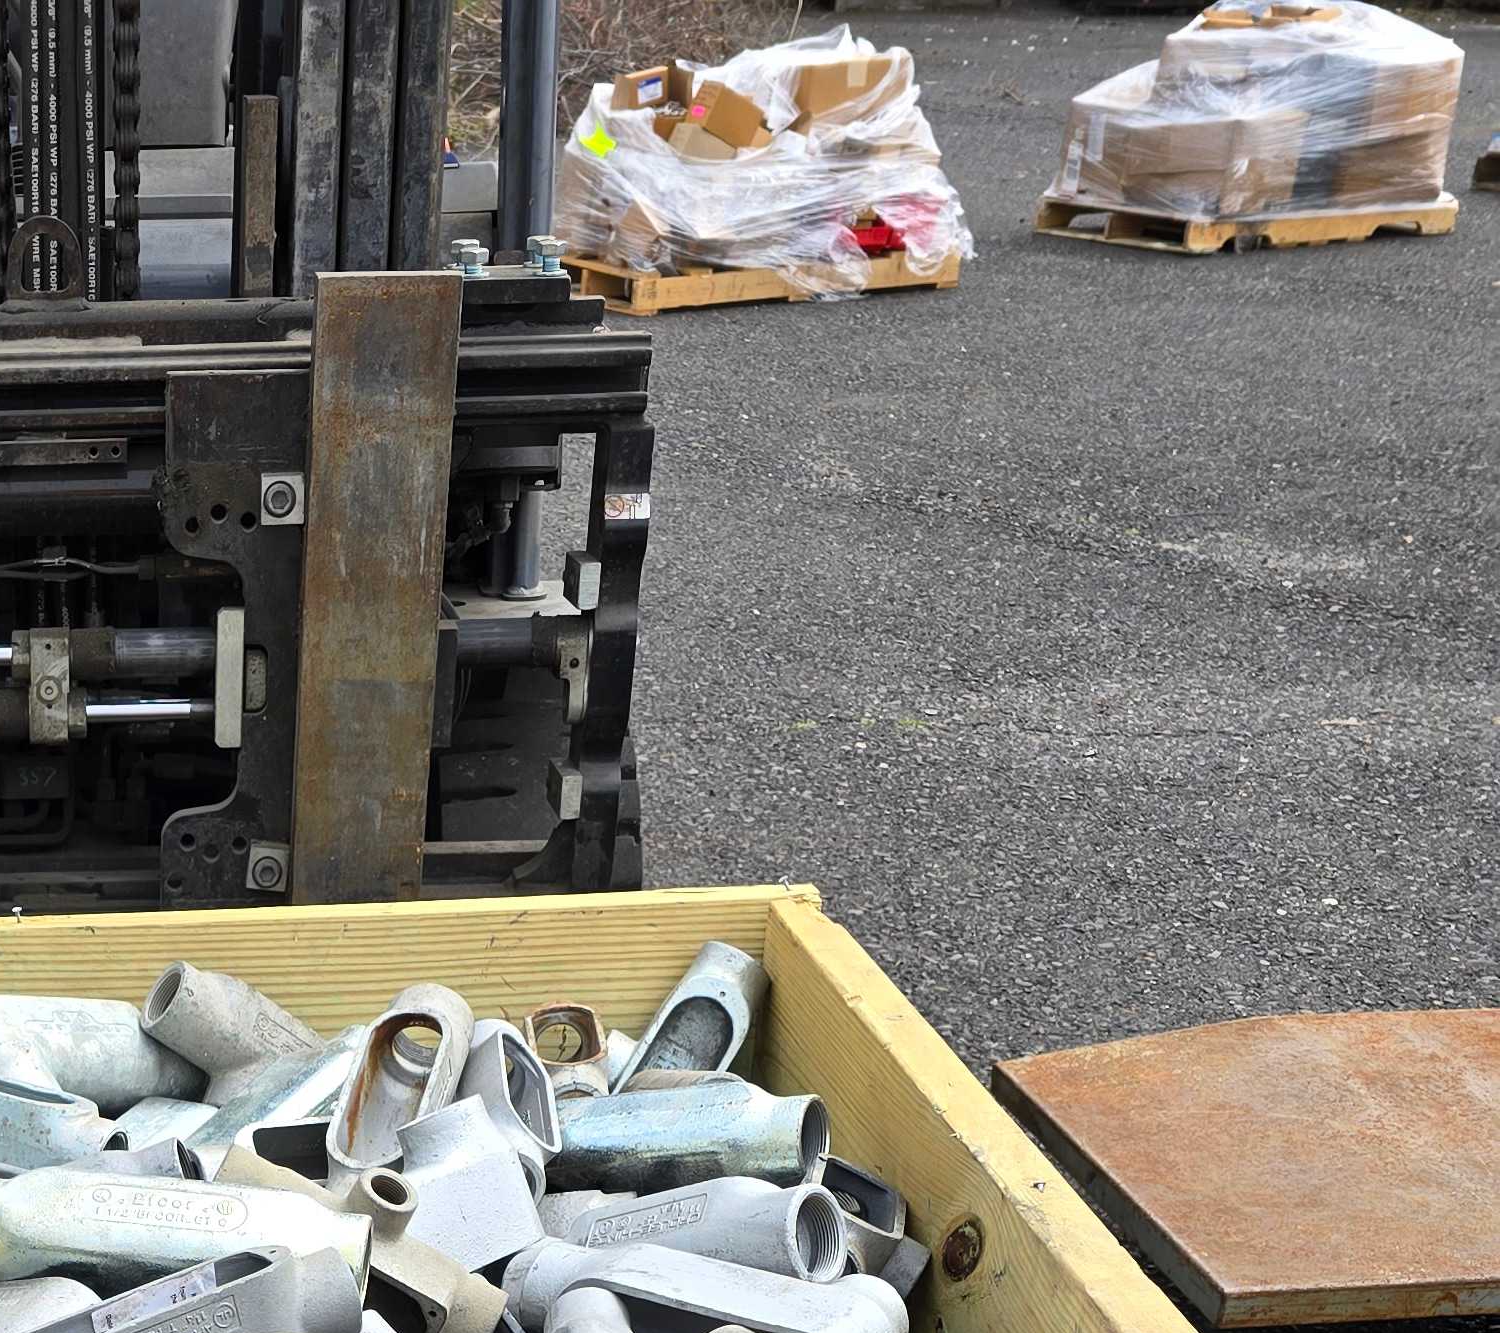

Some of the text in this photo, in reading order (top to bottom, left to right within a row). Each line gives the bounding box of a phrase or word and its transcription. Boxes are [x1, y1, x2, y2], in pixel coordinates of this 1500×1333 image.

[31, 52, 39, 73] WP
[48, 93, 57, 122] 4000
[84, 90, 93, 119] 4000
[49, 124, 58, 145] PSI
[85, 121, 94, 141] PSI
[49, 147, 58, 167] WP
[85, 143, 95, 163] WP
